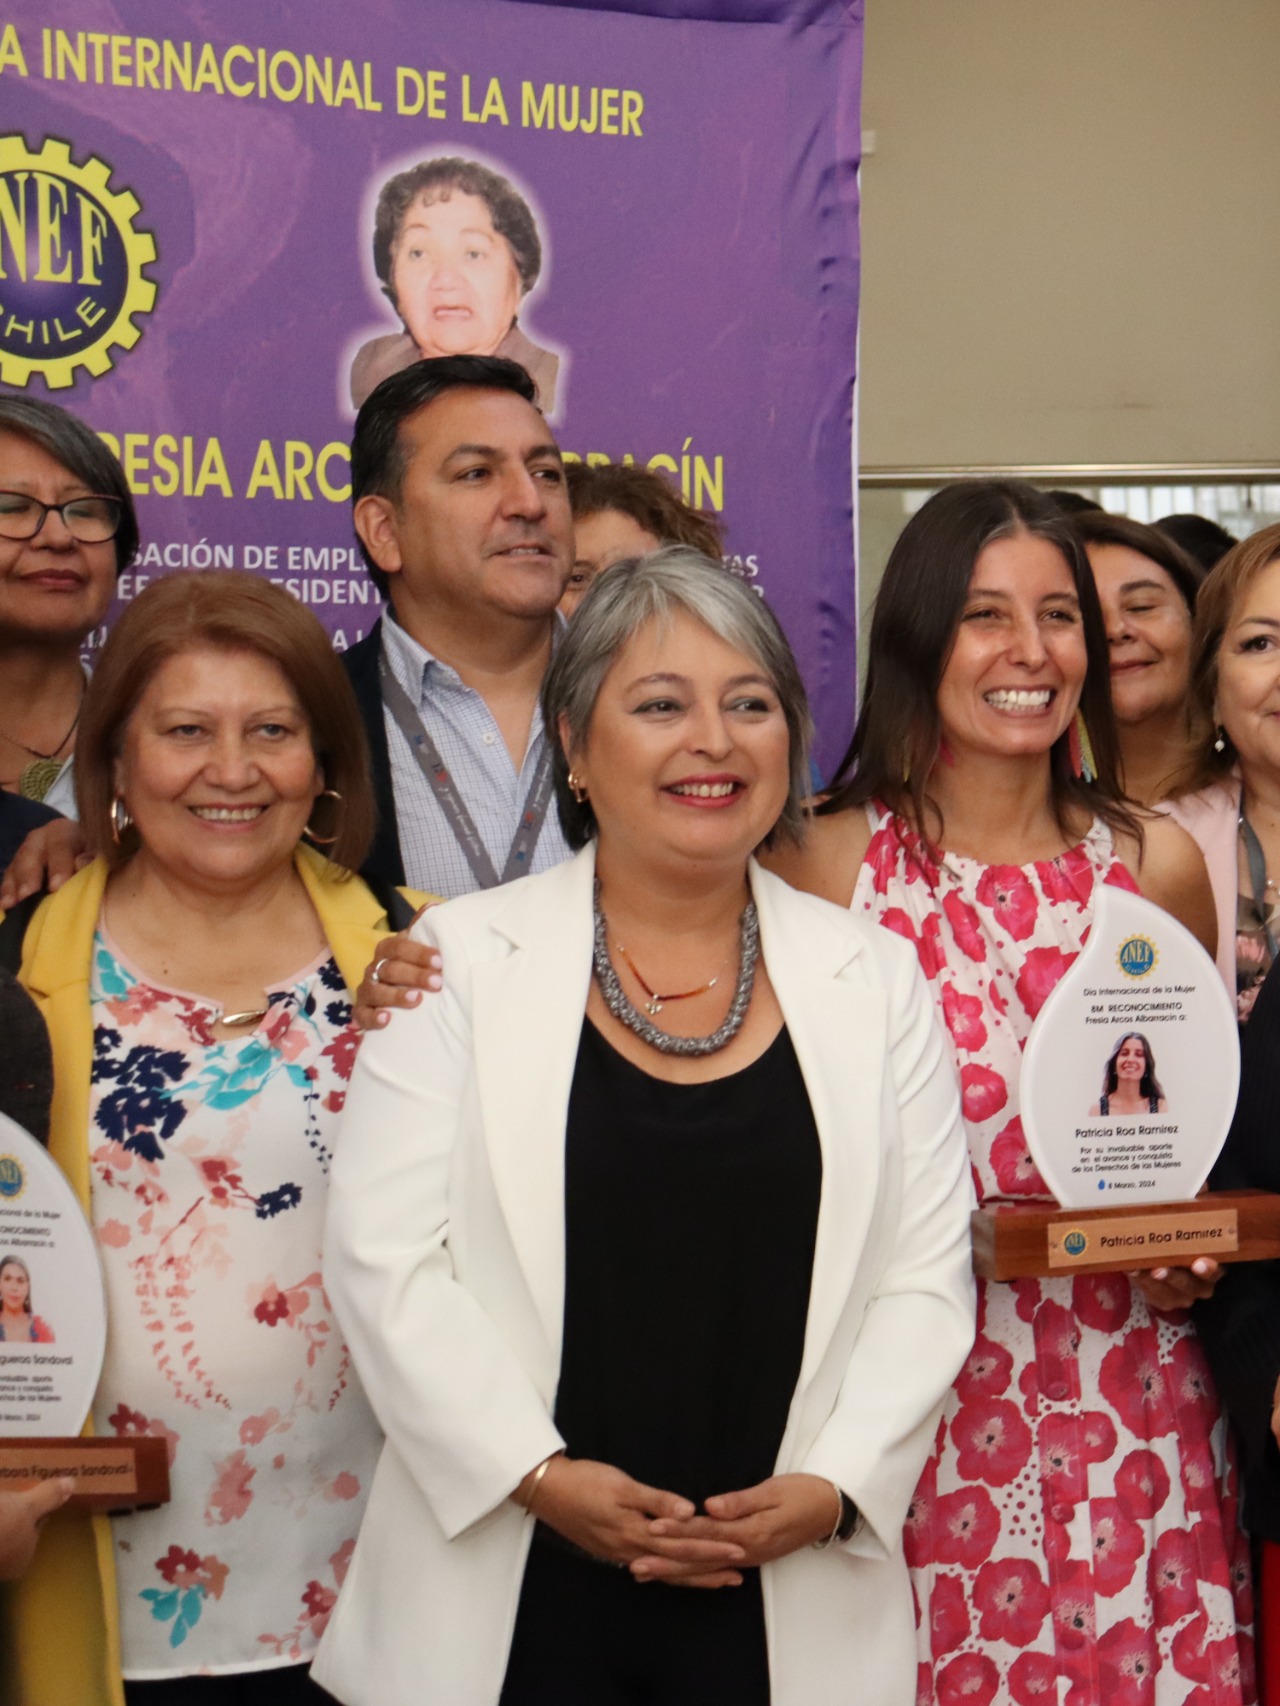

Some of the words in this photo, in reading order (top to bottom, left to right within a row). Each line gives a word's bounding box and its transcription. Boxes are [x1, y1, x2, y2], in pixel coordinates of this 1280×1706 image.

[42, 28, 382, 112] INTERNACIONAL
[396, 66, 446, 119] DE
[461, 74, 509, 125] LA
[522, 80, 645, 136] MUJER
[0, 172, 107, 286] NEF
[0, 296, 106, 344] HILE
[246, 439, 353, 503] ARC
[130, 538, 233, 569] ACIÓN
[243, 545, 279, 569] DE
[287, 546, 369, 572] EMPL
[1099, 986, 1150, 996] Internacional
[1152, 986, 1163, 994] de
[1174, 985, 1196, 995] Mujer
[1108, 1002, 1182, 1012] RECONOCIMIENTO
[1085, 1016, 1109, 1025] Fresia
[1110, 1015, 1133, 1024] Arcos
[1075, 1128, 1113, 1138] Patricia
[1116, 1127, 1136, 1136] Roa
[1071, 1166, 1081, 1174] de
[1095, 1163, 1129, 1172] Derechos
[1130, 1162, 1140, 1170] de
[1154, 1161, 1181, 1170] Mujeres
[1138, 1180, 1156, 1188] 2024
[1101, 1236, 1145, 1248] Patricia
[1149, 1232, 1172, 1243] Roa
